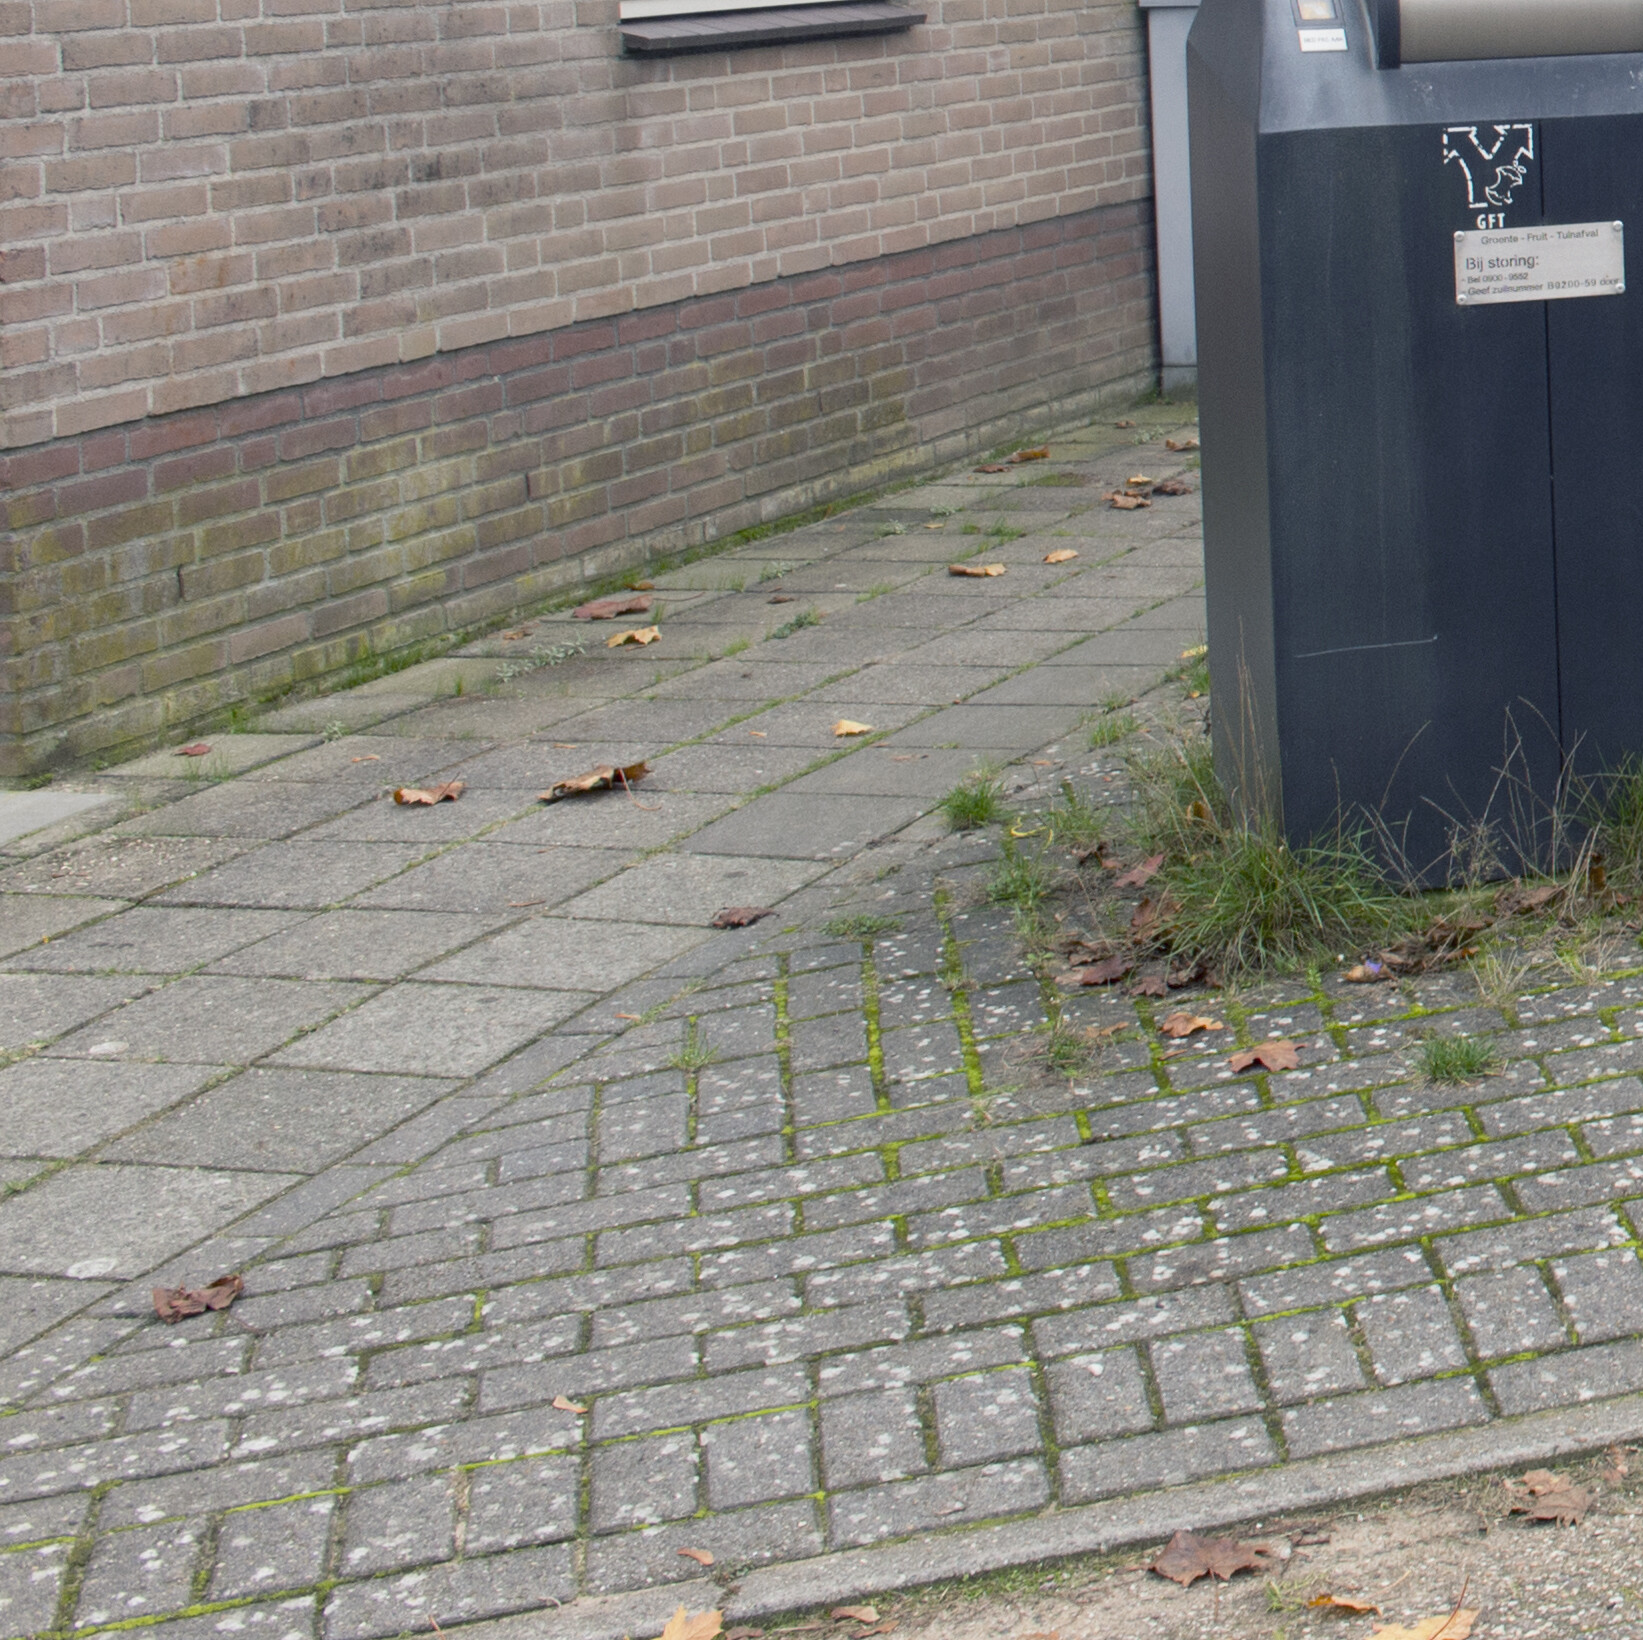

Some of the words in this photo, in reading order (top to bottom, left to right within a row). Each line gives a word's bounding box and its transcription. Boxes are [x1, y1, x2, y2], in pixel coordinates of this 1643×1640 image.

[1476, 212, 1506, 230] GFT
[1480, 235, 1519, 246] Groente
[1526, 232, 1549, 242] Fruit
[1556, 228, 1599, 240] Tuinafval
[1466, 257, 1484, 272] Bij
[1488, 254, 1540, 269] storing:
